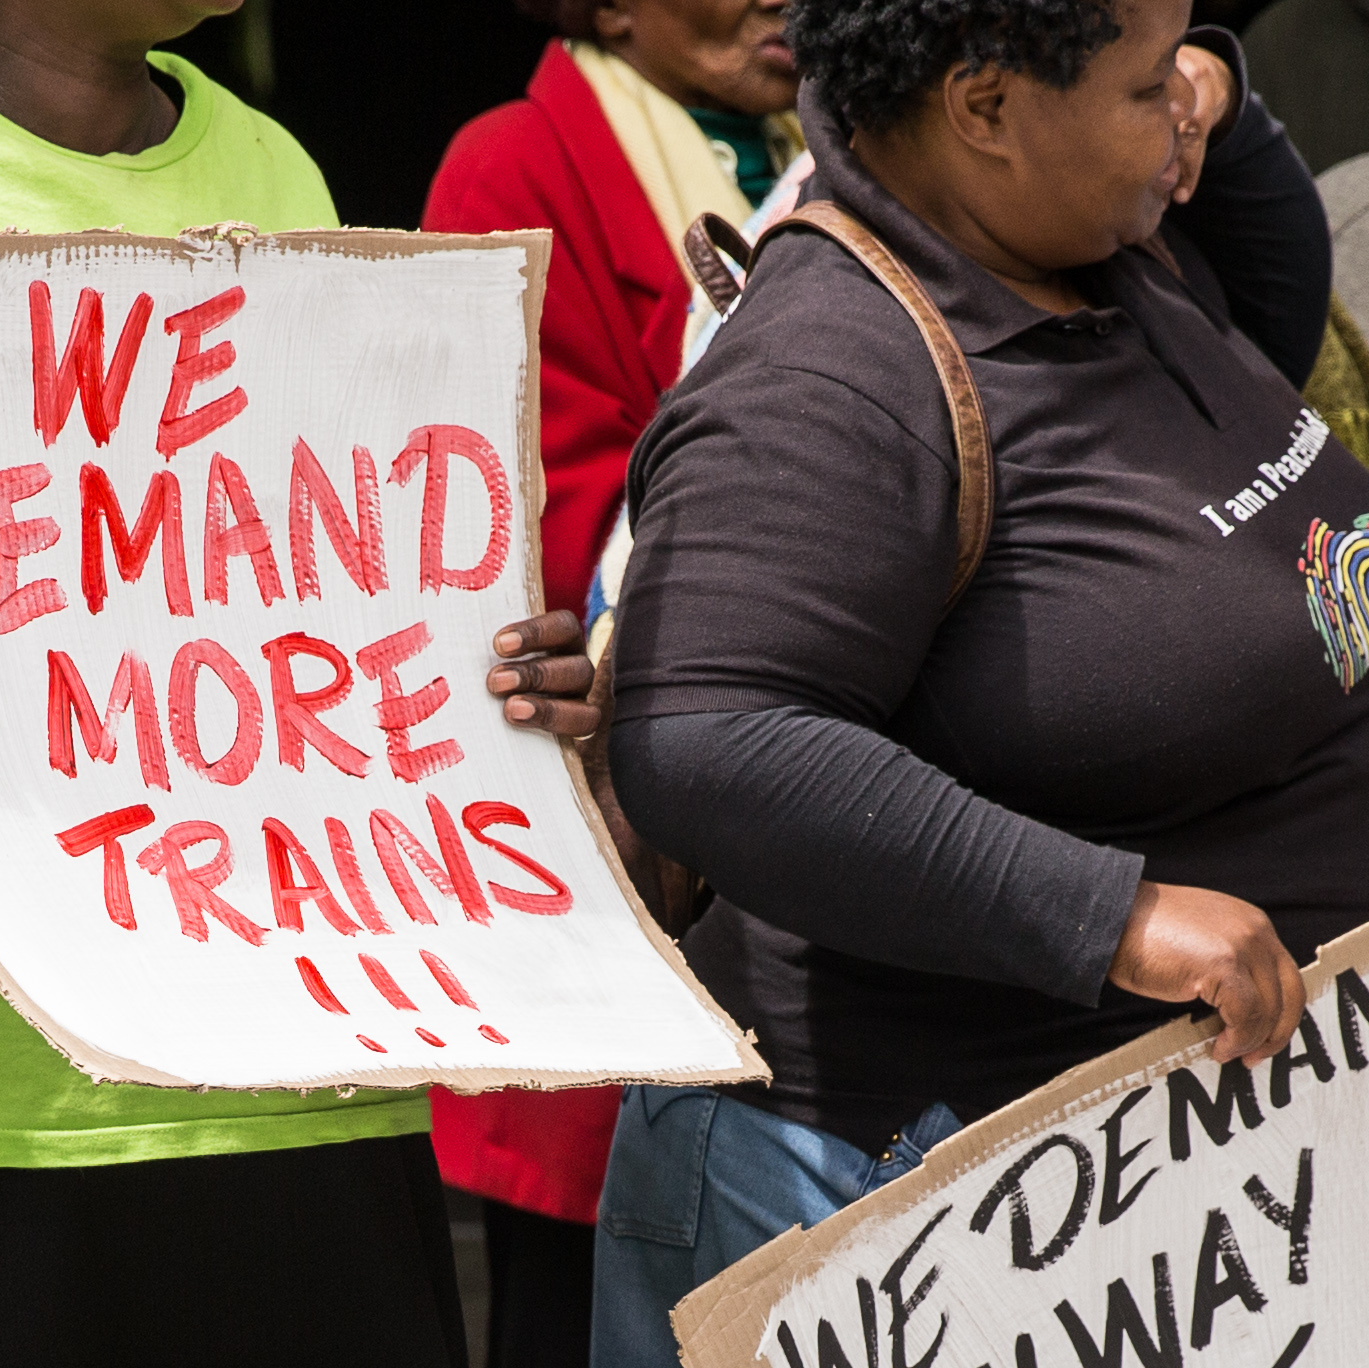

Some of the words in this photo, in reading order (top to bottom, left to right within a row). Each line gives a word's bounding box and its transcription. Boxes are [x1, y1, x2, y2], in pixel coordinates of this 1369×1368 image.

[28, 279, 250, 464] WE
[1200, 505, 1235, 537] I
[1225, 489, 1268, 522] am
[1253, 479, 1279, 502] a
[46, 620, 466, 794] MORE
[54, 793, 575, 949] TRAINS
[294, 948, 511, 1055] !!!
